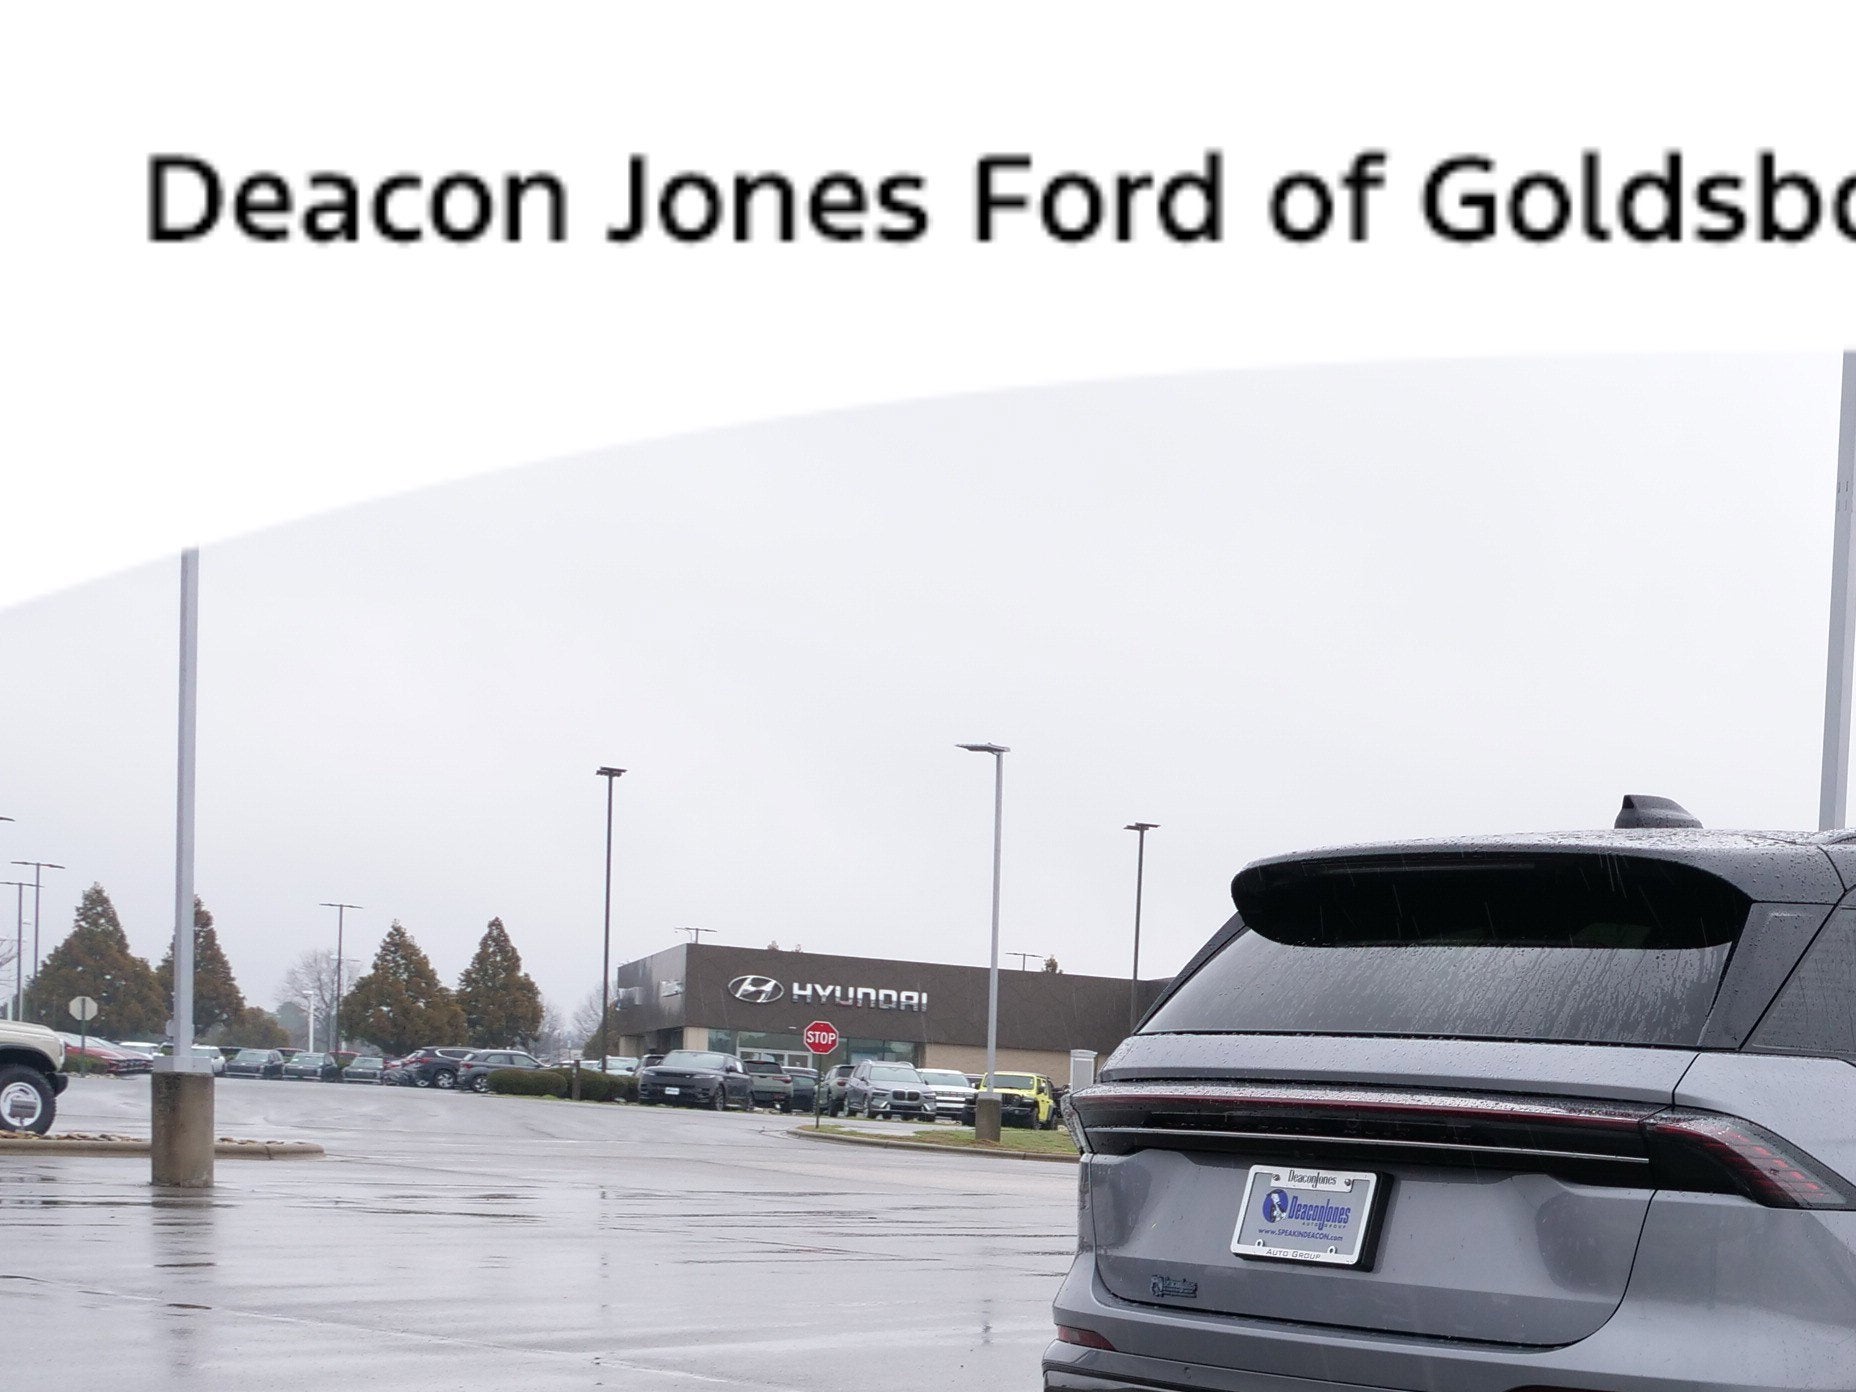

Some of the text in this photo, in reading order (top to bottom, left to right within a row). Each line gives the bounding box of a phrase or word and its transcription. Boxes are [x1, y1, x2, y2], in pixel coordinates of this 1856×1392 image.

[792, 982, 928, 1012] HYUNDAI
[806, 1030, 836, 1045] STOP
[1288, 1195, 1351, 1230] DeaconJones
[1258, 1228, 1343, 1241] www.SPEAKINDEACON.com
